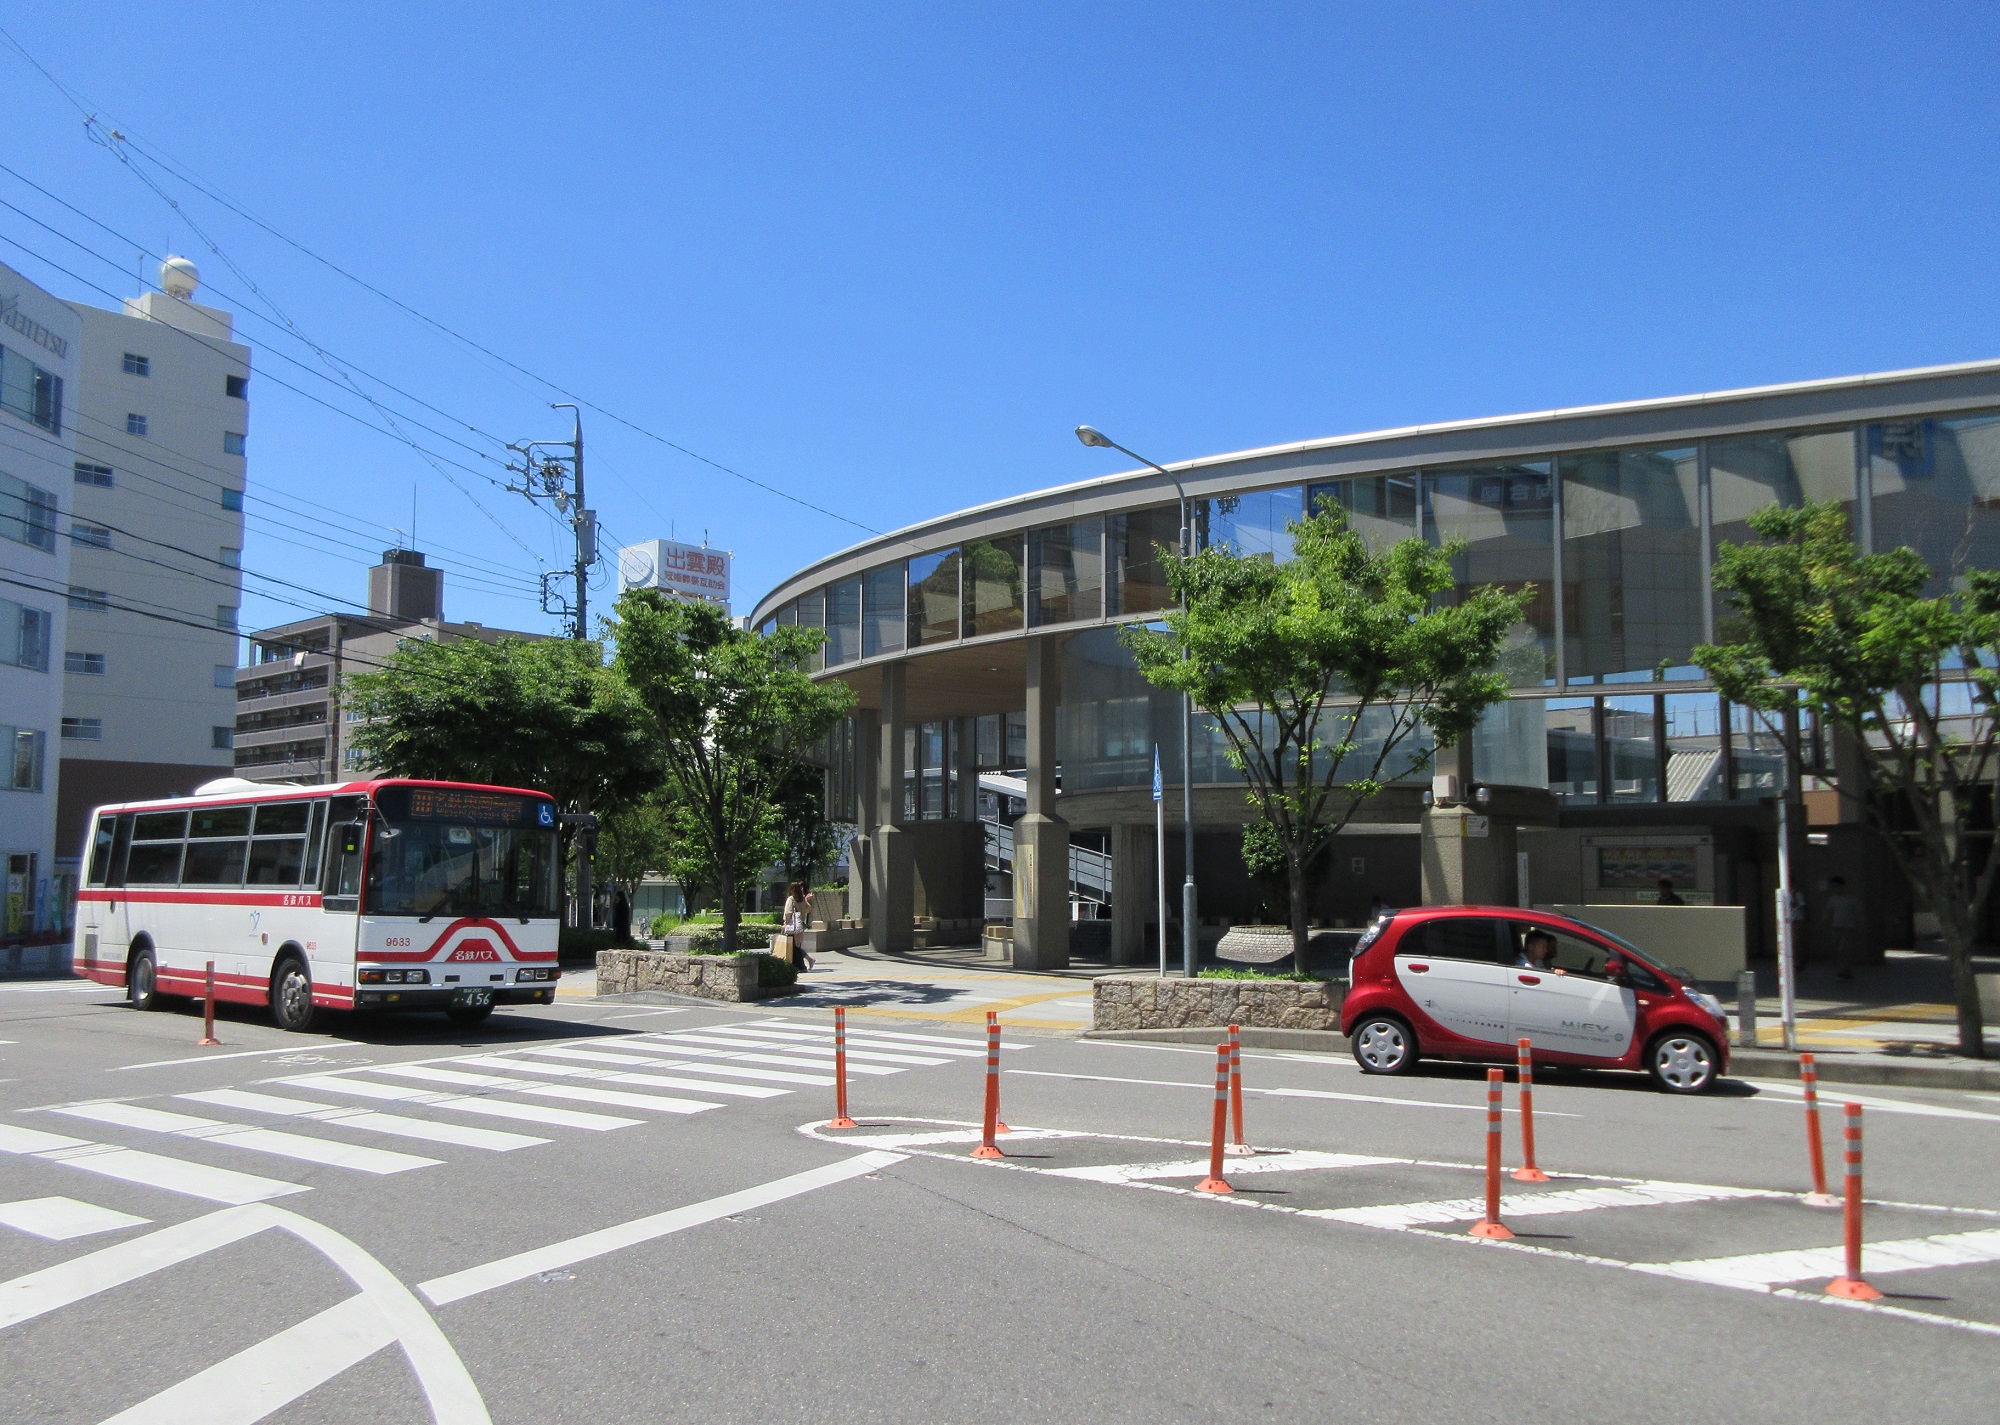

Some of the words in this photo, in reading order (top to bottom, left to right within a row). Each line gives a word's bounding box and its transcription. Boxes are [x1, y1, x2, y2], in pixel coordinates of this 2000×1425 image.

[666, 547, 726, 578] 出雲殿
[283, 894, 312, 906] 名鉄バス
[385, 937, 411, 947] 9633
[455, 950, 494, 961] 名鉄バス
